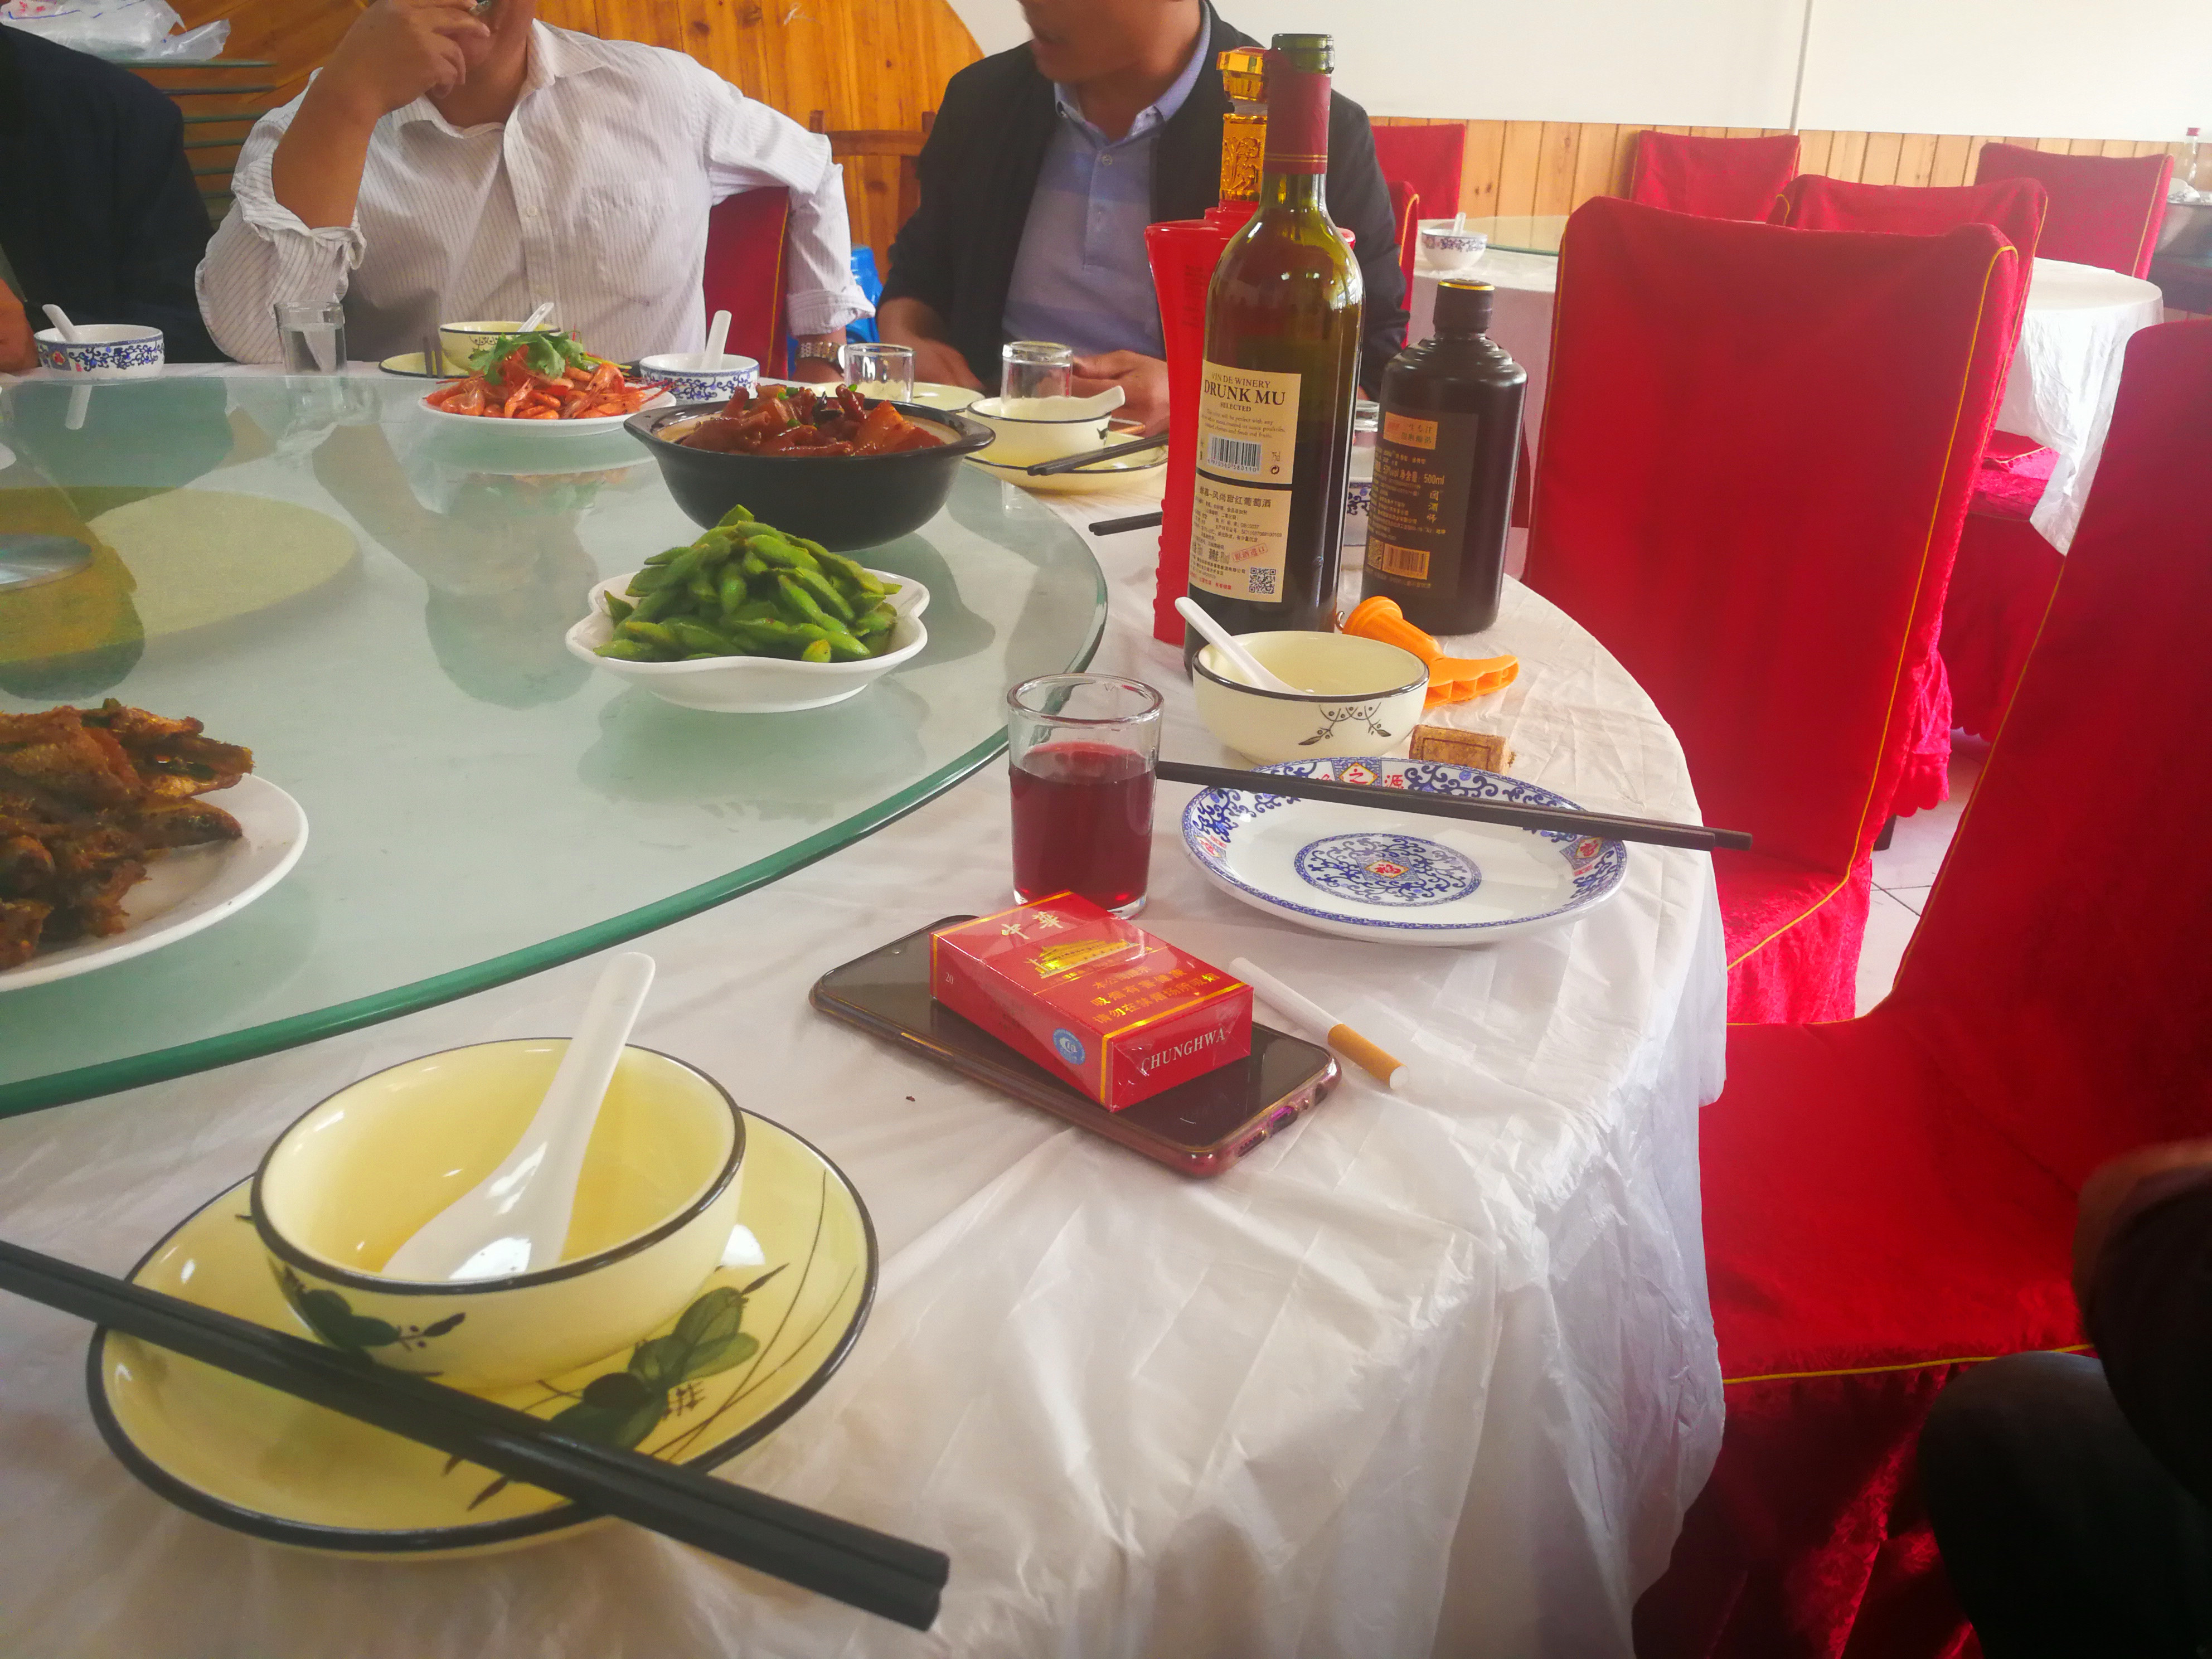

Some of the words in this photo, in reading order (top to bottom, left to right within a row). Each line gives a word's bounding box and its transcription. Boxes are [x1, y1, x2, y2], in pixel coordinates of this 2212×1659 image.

[1212, 372, 1222, 381] VIN
[1223, 375, 1234, 384] DE
[1235, 377, 1270, 389] WINERY
[1204, 380, 1251, 402] DRUNK
[1255, 390, 1286, 405] MU
[1220, 402, 1251, 412] SELECTED
[1424, 473, 1445, 485] 500ml
[945, 972, 954, 984] 20
[1090, 968, 1187, 1007] 吸烟有害健康
[1092, 973, 1220, 1023] 请勿在禁烟场所吸烟
[1141, 1027, 1225, 1072] CHUNGHWA
